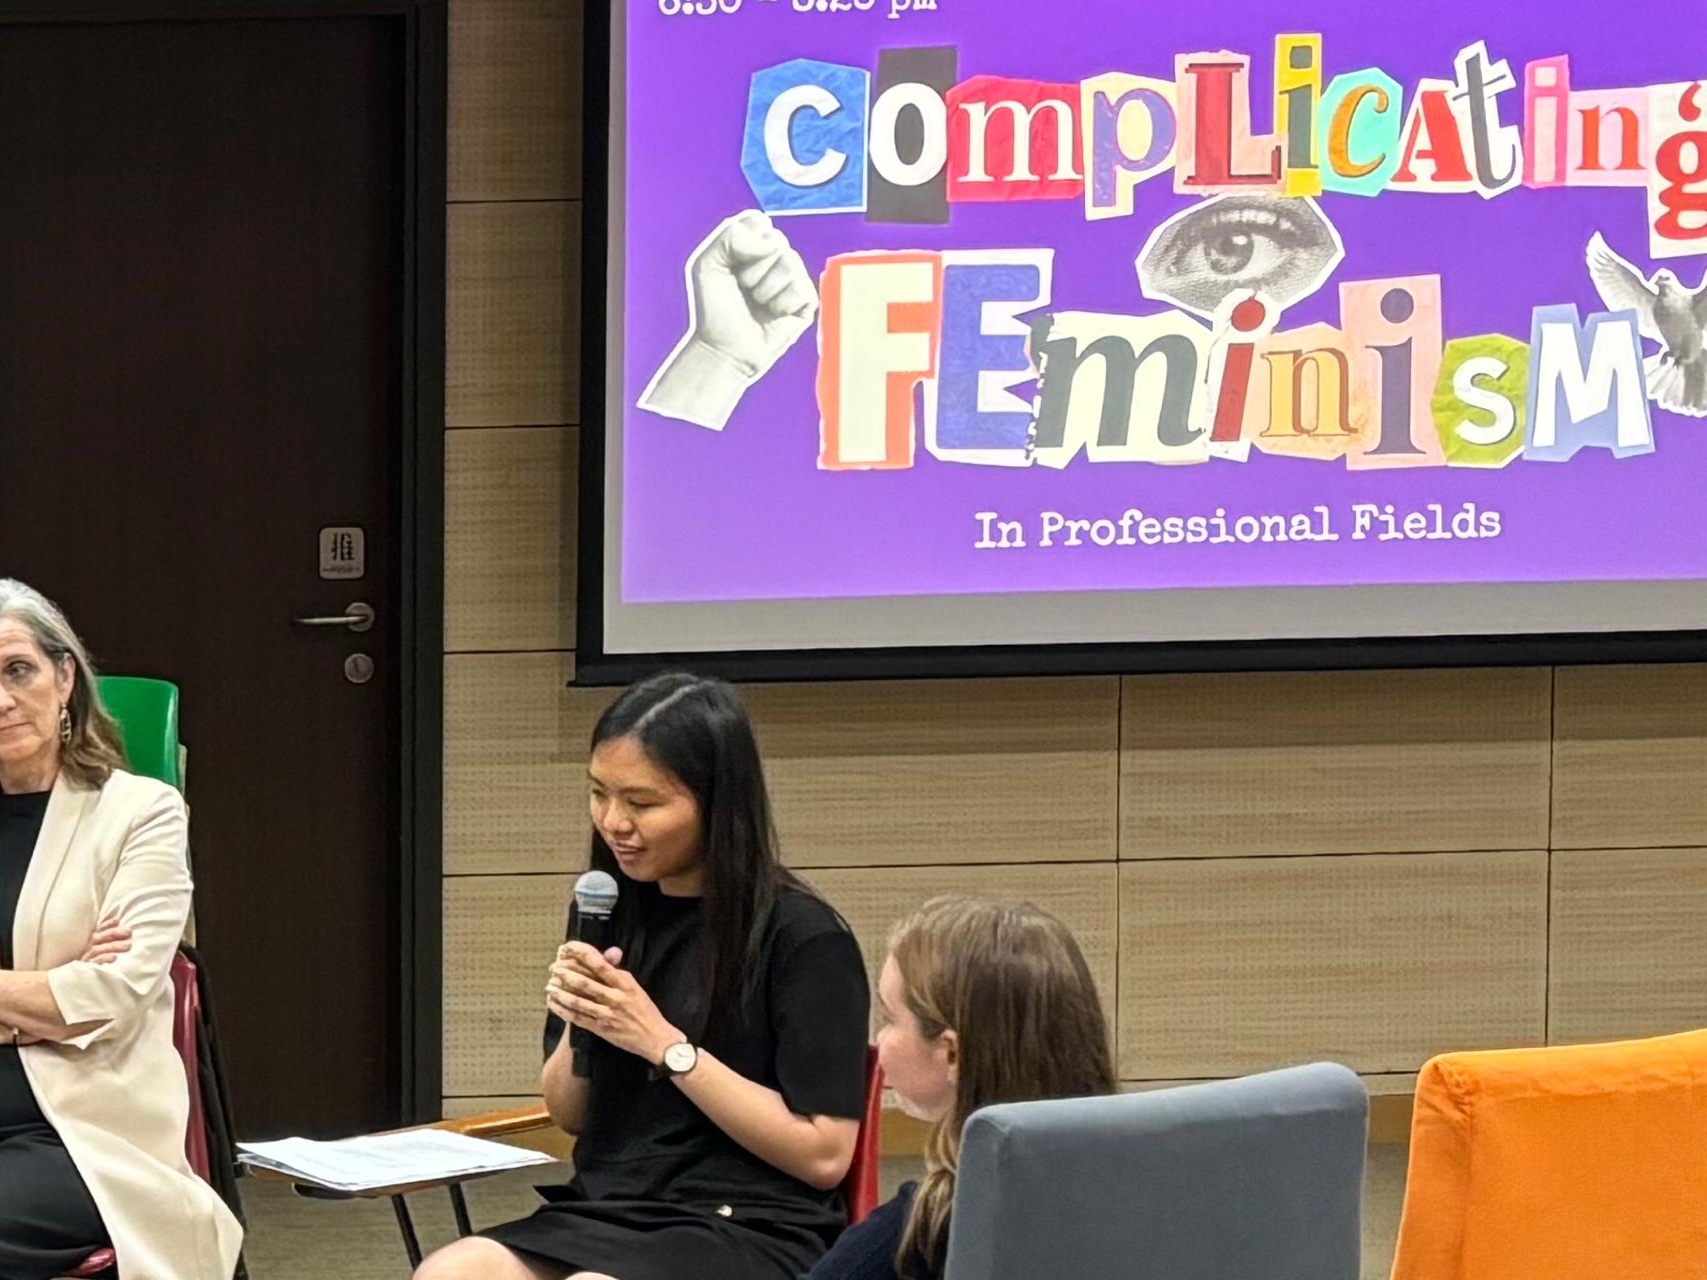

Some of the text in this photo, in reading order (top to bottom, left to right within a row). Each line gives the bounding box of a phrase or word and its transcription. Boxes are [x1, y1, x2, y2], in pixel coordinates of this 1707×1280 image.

[974, 503, 1502, 549] In Professional Fields
